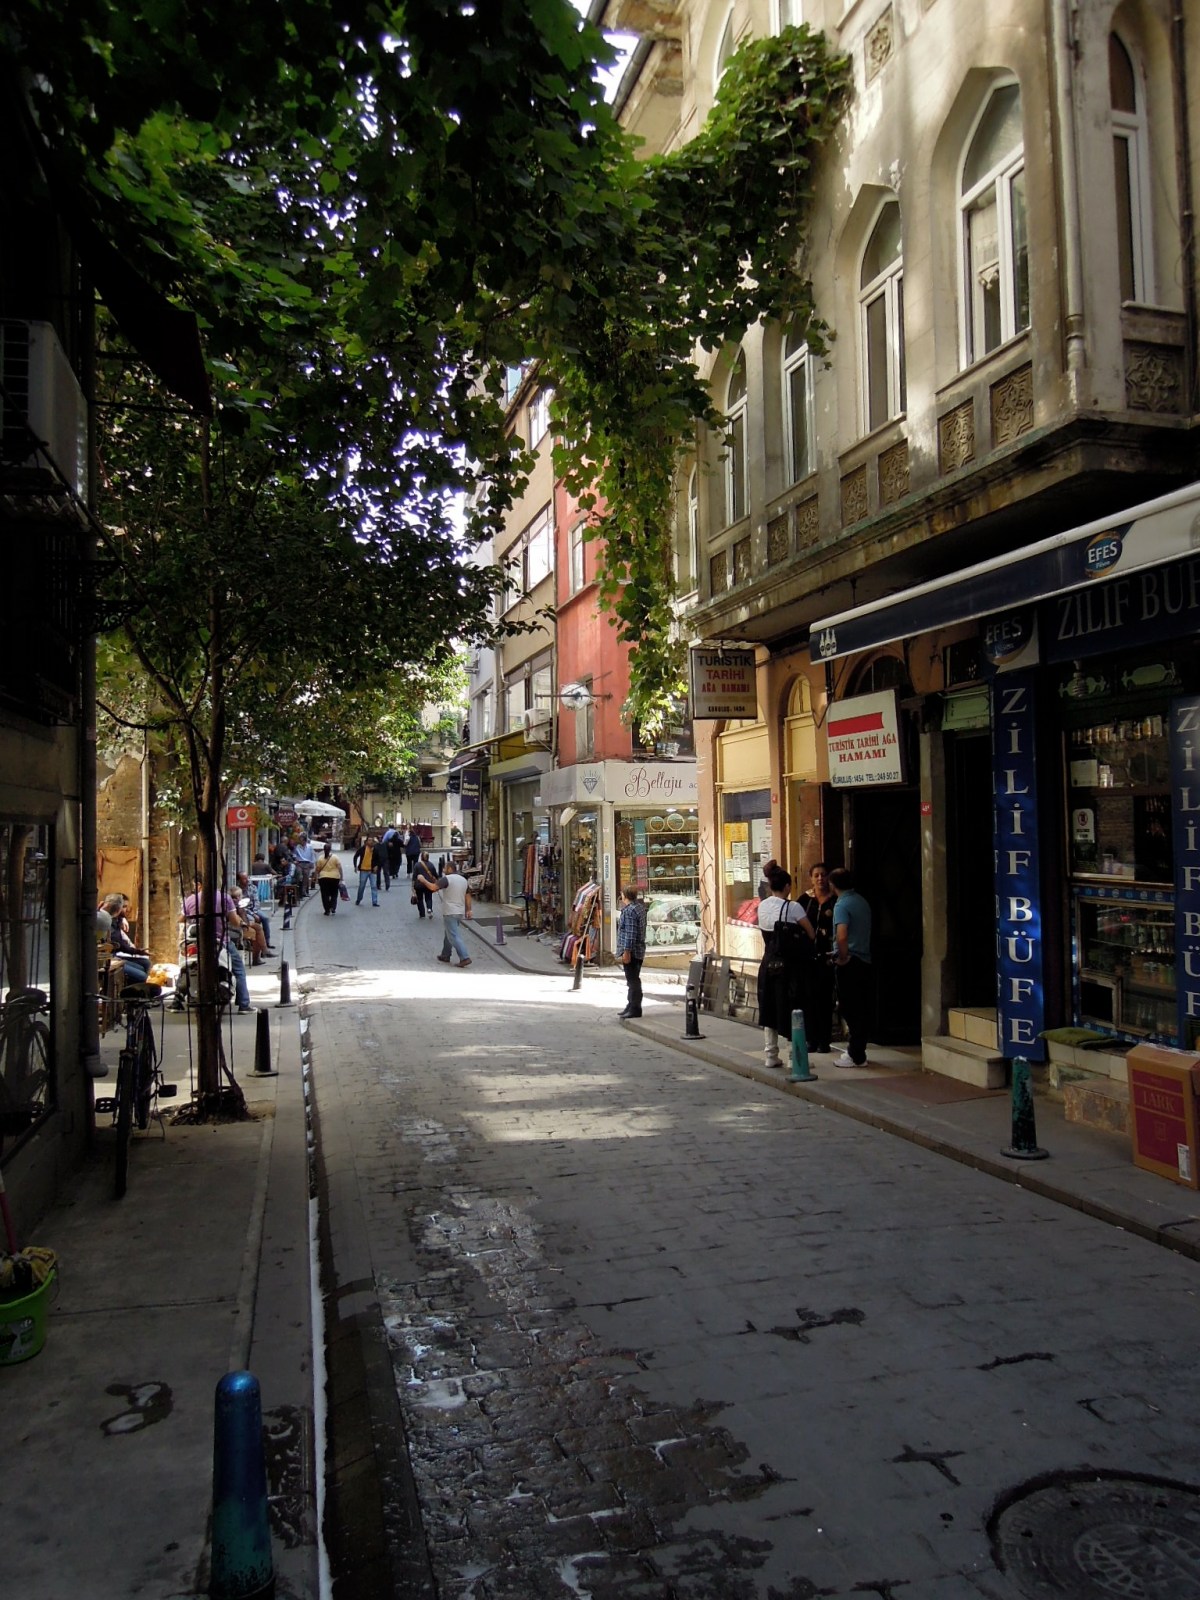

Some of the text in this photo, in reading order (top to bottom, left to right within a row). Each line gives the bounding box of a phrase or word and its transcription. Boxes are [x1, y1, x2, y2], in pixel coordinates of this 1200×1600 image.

[1087, 541, 1118, 564] EFES
[985, 615, 1023, 645] EFES
[721, 683, 750, 693] HAMAMI
[882, 733, 897, 745] AĞA
[839, 748, 887, 763] HAMAMI
[624, 765, 683, 798] Bellaju
